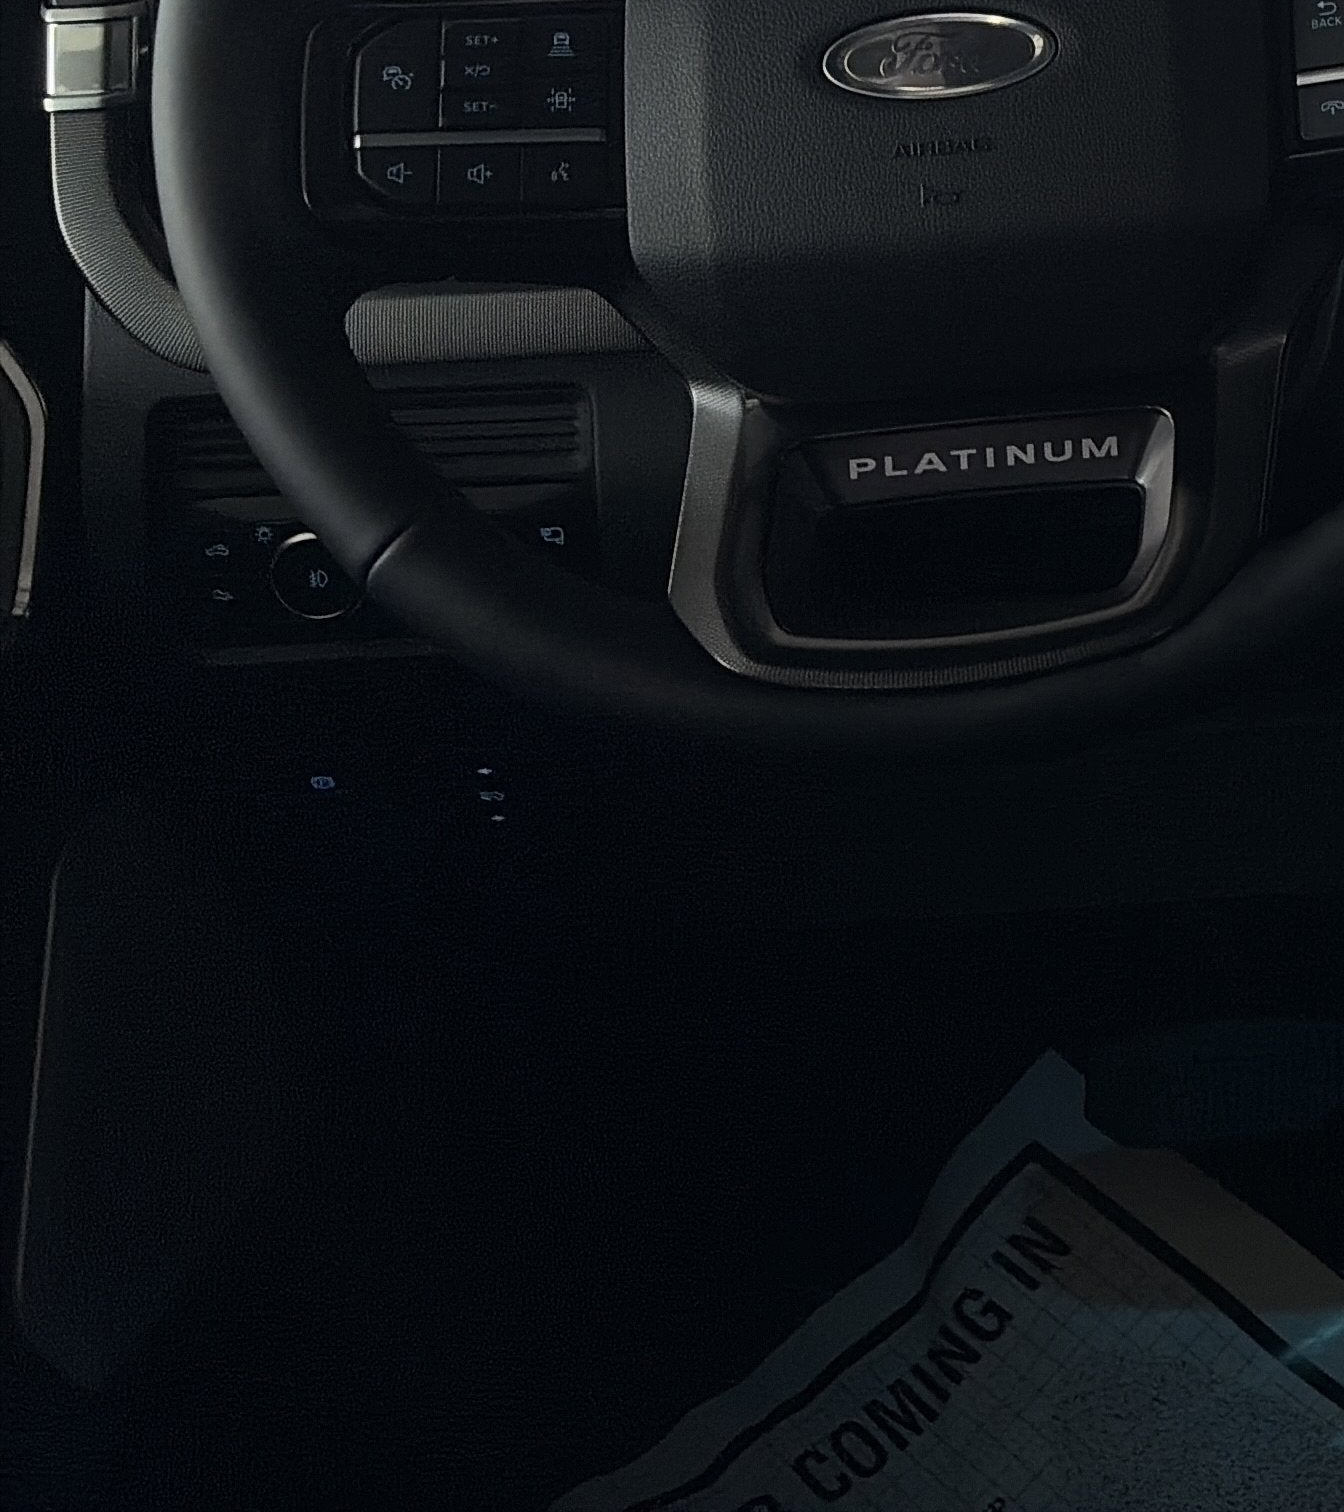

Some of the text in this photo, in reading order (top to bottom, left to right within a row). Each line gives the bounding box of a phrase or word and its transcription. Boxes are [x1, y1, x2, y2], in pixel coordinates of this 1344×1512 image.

[1311, 16, 1342, 30] BACK
[846, 435, 1121, 483] PLATINUM
[792, 1216, 1071, 1503] COMING IN
